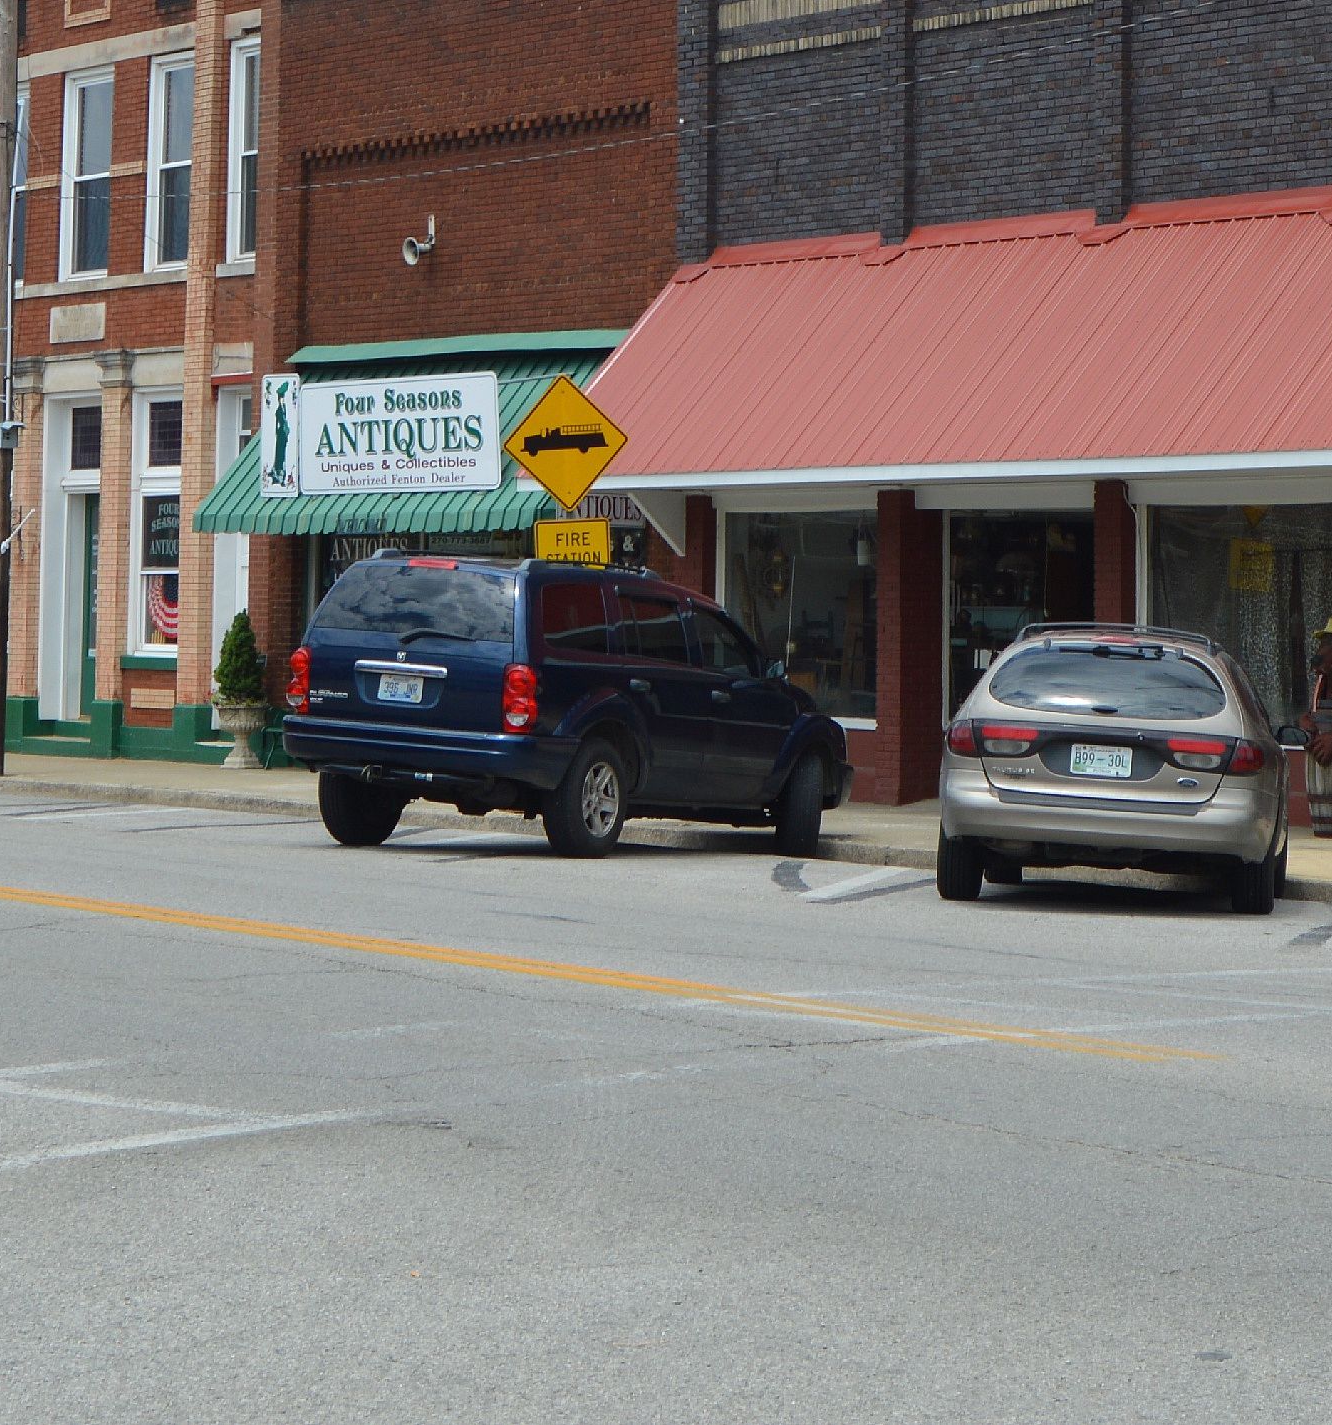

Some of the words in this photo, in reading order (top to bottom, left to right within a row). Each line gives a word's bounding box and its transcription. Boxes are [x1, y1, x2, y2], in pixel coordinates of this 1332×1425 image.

[334, 393, 375, 416] Four
[384, 388, 463, 413] Seasons
[315, 414, 484, 459] ANTIQUES
[321, 460, 375, 474] Uniques
[381, 459, 391, 471] &
[395, 456, 477, 470] Collectibles
[332, 474, 387, 487] Authorized
[391, 473, 426, 485] Fenton
[431, 471, 466, 484] Dealer
[151, 516, 179, 533] SEASO
[150, 539, 179, 557] ANTIQU
[555, 531, 591, 548] FIRE
[622, 535, 634, 552] &
